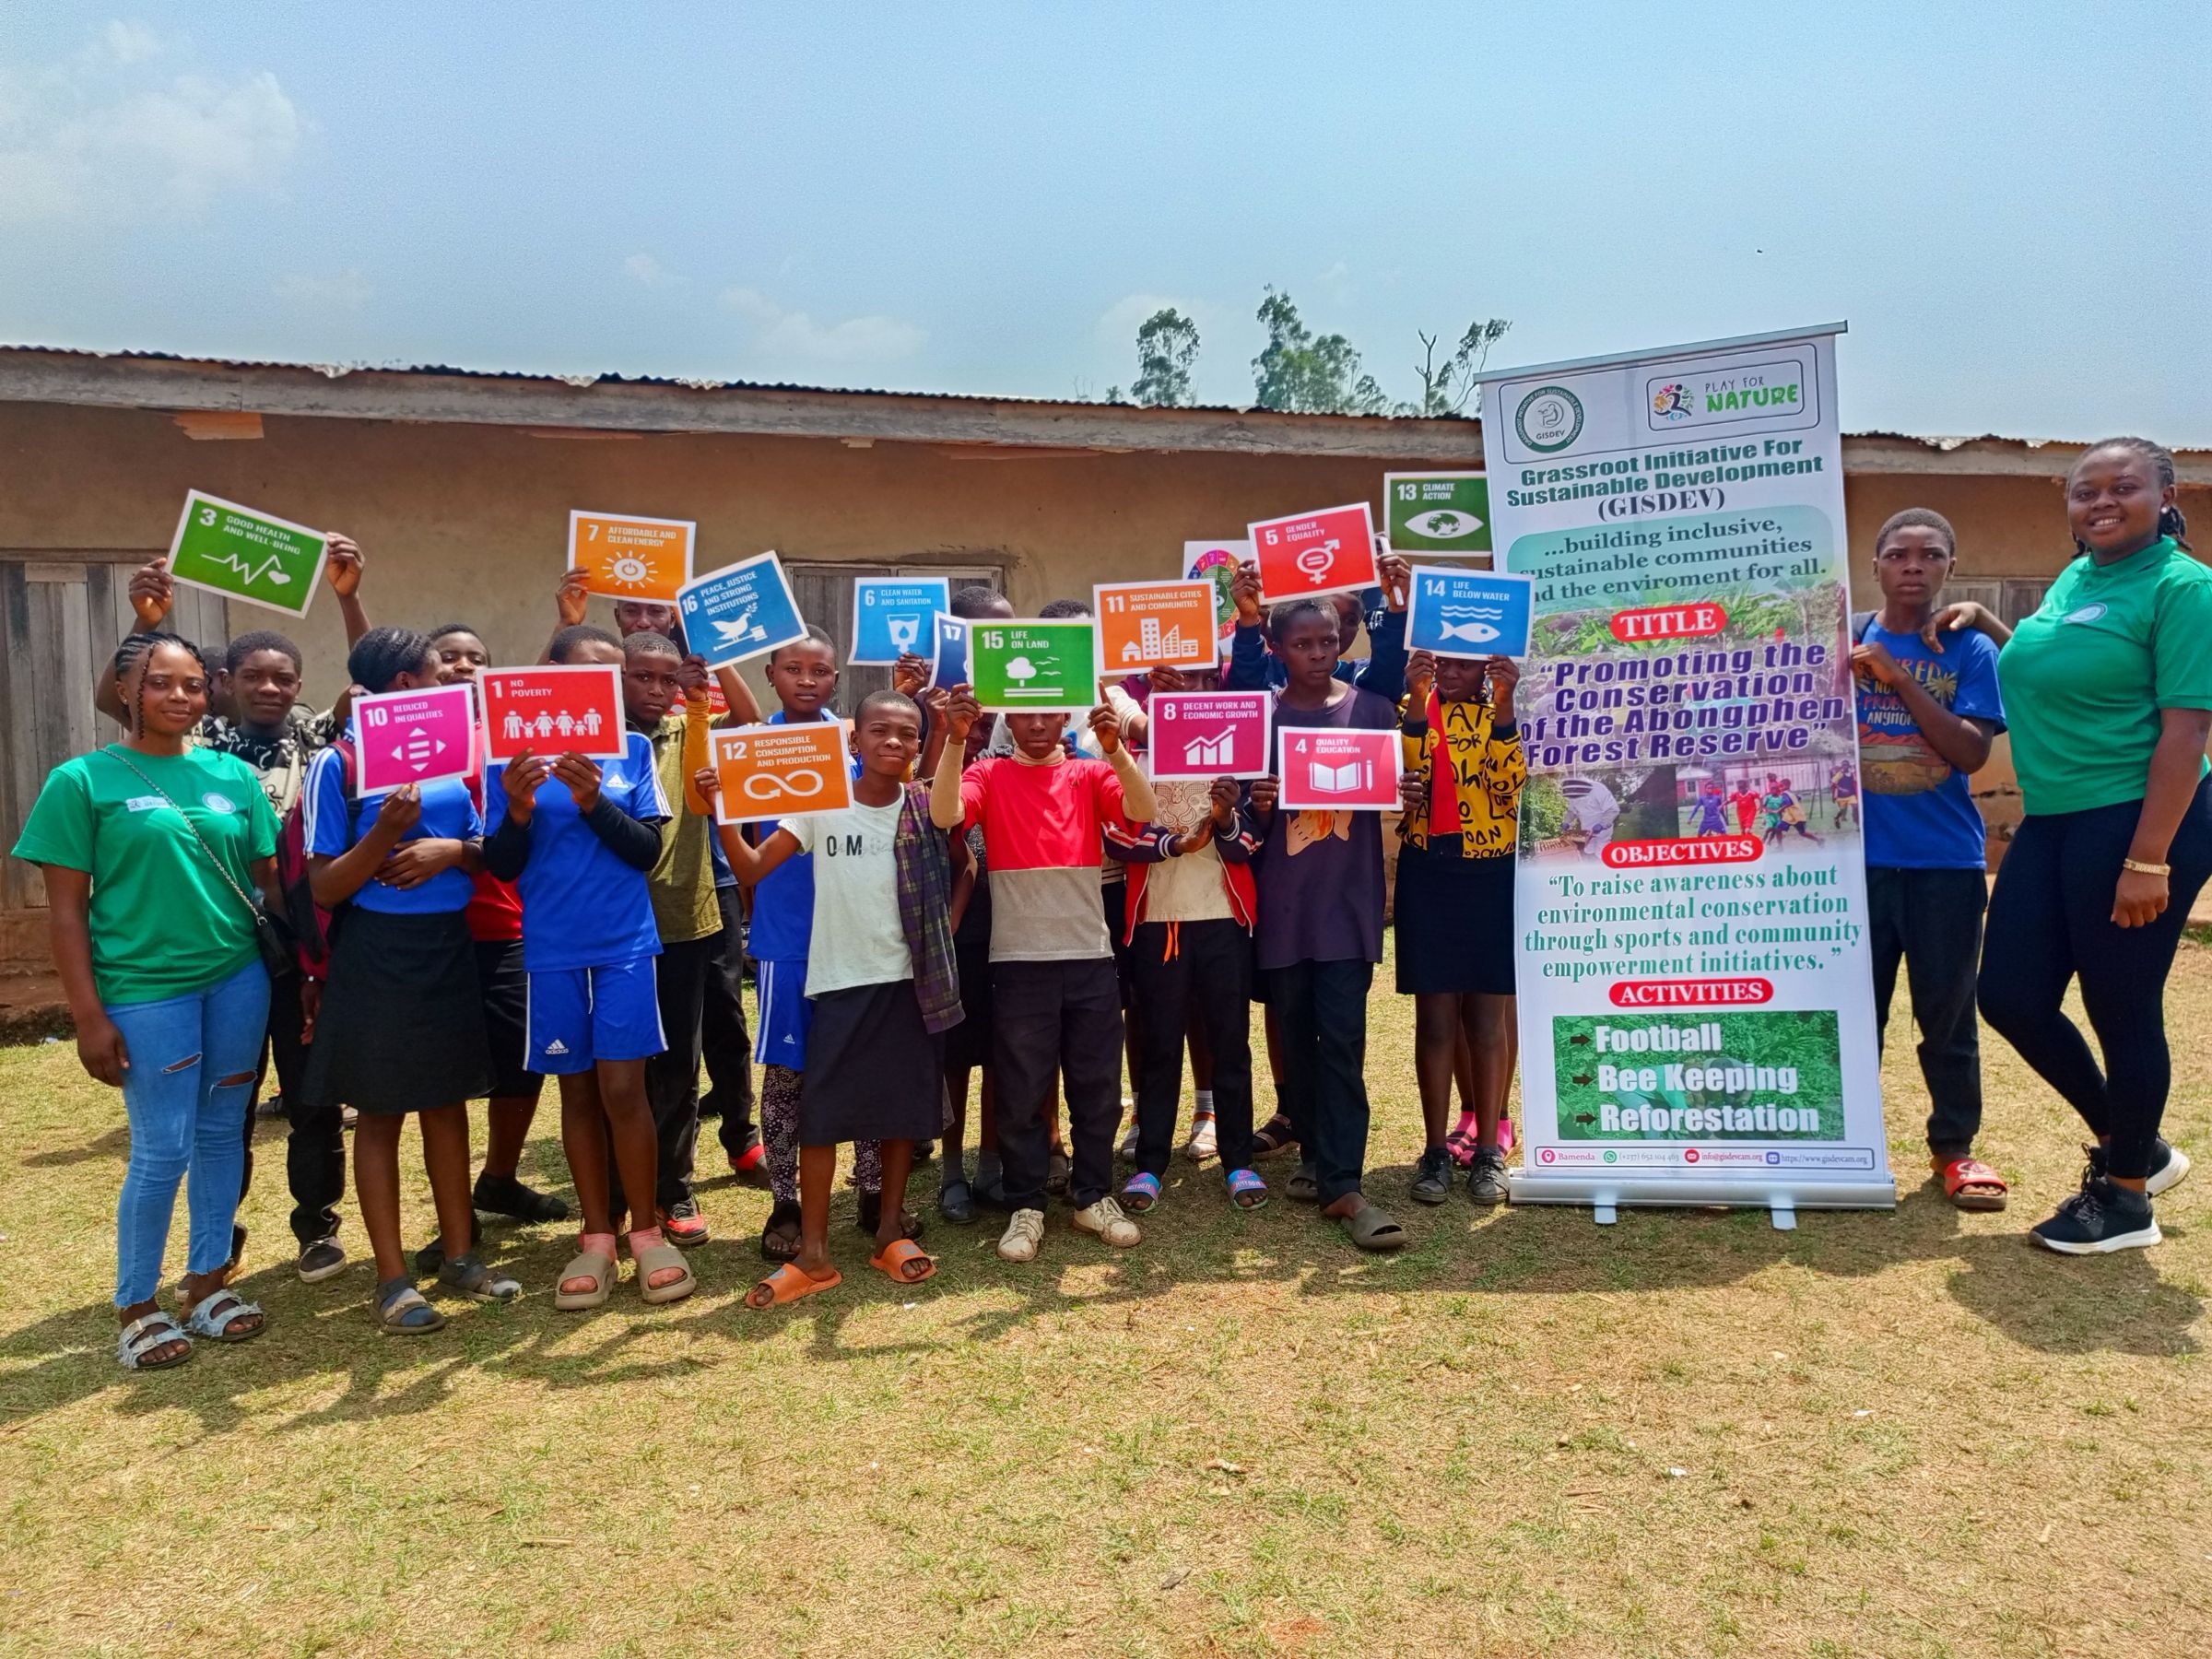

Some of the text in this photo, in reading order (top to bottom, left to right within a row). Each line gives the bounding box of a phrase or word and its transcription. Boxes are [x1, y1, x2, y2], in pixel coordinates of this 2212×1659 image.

[1705, 376, 1764, 393] PLAY FOR
[1706, 383, 1799, 413] NATURE
[1535, 429, 1566, 441] GISDEV
[1521, 440, 1803, 487] Grassroot Initiative For
[1397, 483, 1454, 500] 13 CLIMATE
[1507, 456, 1823, 507] Sustainable Development
[1422, 492, 1451, 500] ACTION
[1598, 488, 1724, 522] (GISDEV)
[199, 508, 291, 542] 3 GOOD HEALTH
[223, 524, 244, 536] AND
[588, 524, 677, 542] 7 AFFORDABLE AND
[1265, 522, 1317, 546] 5 GENDER
[1287, 528, 1325, 542] EQUALITY
[607, 535, 665, 547] CLEAN ENERGY
[1545, 518, 1783, 557] ...building inclusive,
[1654, 537, 1812, 566] communities
[1425, 579, 1469, 597] 14 LIFE
[1561, 582, 1596, 599] the
[1603, 567, 1741, 594] enviroment
[1747, 563, 1783, 581] for
[1790, 558, 1827, 576] all.
[682, 594, 699, 616] 16
[726, 571, 759, 589] JUSTICE
[704, 583, 752, 606] AND STRONG
[707, 591, 759, 616] INSTITUTIONS
[865, 589, 876, 606] 6
[881, 597, 932, 606] AND SANITATION
[1106, 590, 1202, 614] 11 SUSTAINABLE CITIES
[1453, 590, 1511, 602] BELOW WATER
[1130, 599, 1198, 612] AND COMMUNITIES
[943, 625, 961, 641] 17
[1619, 608, 1717, 638] TITLE
[982, 630, 1029, 650] 15 LIFE
[1011, 640, 1050, 649] ON LAND
[1764, 642, 1826, 668] the
[491, 679, 524, 699] 1 NO
[511, 688, 552, 698] POVERTY
[1555, 672, 1813, 712] Conservation
[365, 701, 429, 727] 10 REDUCED
[394, 710, 443, 724] INEQUALITIES
[1164, 702, 1176, 721] 8
[1183, 702, 1214, 711] DECENT
[1215, 701, 1239, 710] WORK
[1183, 710, 1258, 720] ECONOMIC GROWTH
[1520, 717, 1547, 742] of
[1556, 713, 1613, 738] the
[1623, 698, 1843, 734] Abongphen
[723, 735, 811, 760] 12 RESPONSIBLE
[756, 745, 817, 758] CONSUMPTION
[1295, 738, 1307, 754] 4
[1316, 746, 1361, 754] EDUCATION
[1527, 737, 1640, 768] Forest
[757, 753, 831, 768] AND PRODUCTION
[1611, 840, 1754, 865] OBJECTIVES
[1591, 874, 1644, 896] raise
[1651, 872, 1765, 893] awareness
[1772, 865, 1837, 888] about
[1537, 891, 1848, 924] environmental conservation
[1525, 918, 1862, 956] through sports and community
[1543, 953, 1693, 982] empowerment
[1619, 982, 1764, 1004] ACTIVITIES
[1595, 1022, 1722, 1053] Football
[1597, 1063, 1797, 1095] Bee Keeping
[1600, 1102, 1819, 1132] Reforestation
[1559, 1152, 1595, 1160] Bamenda
